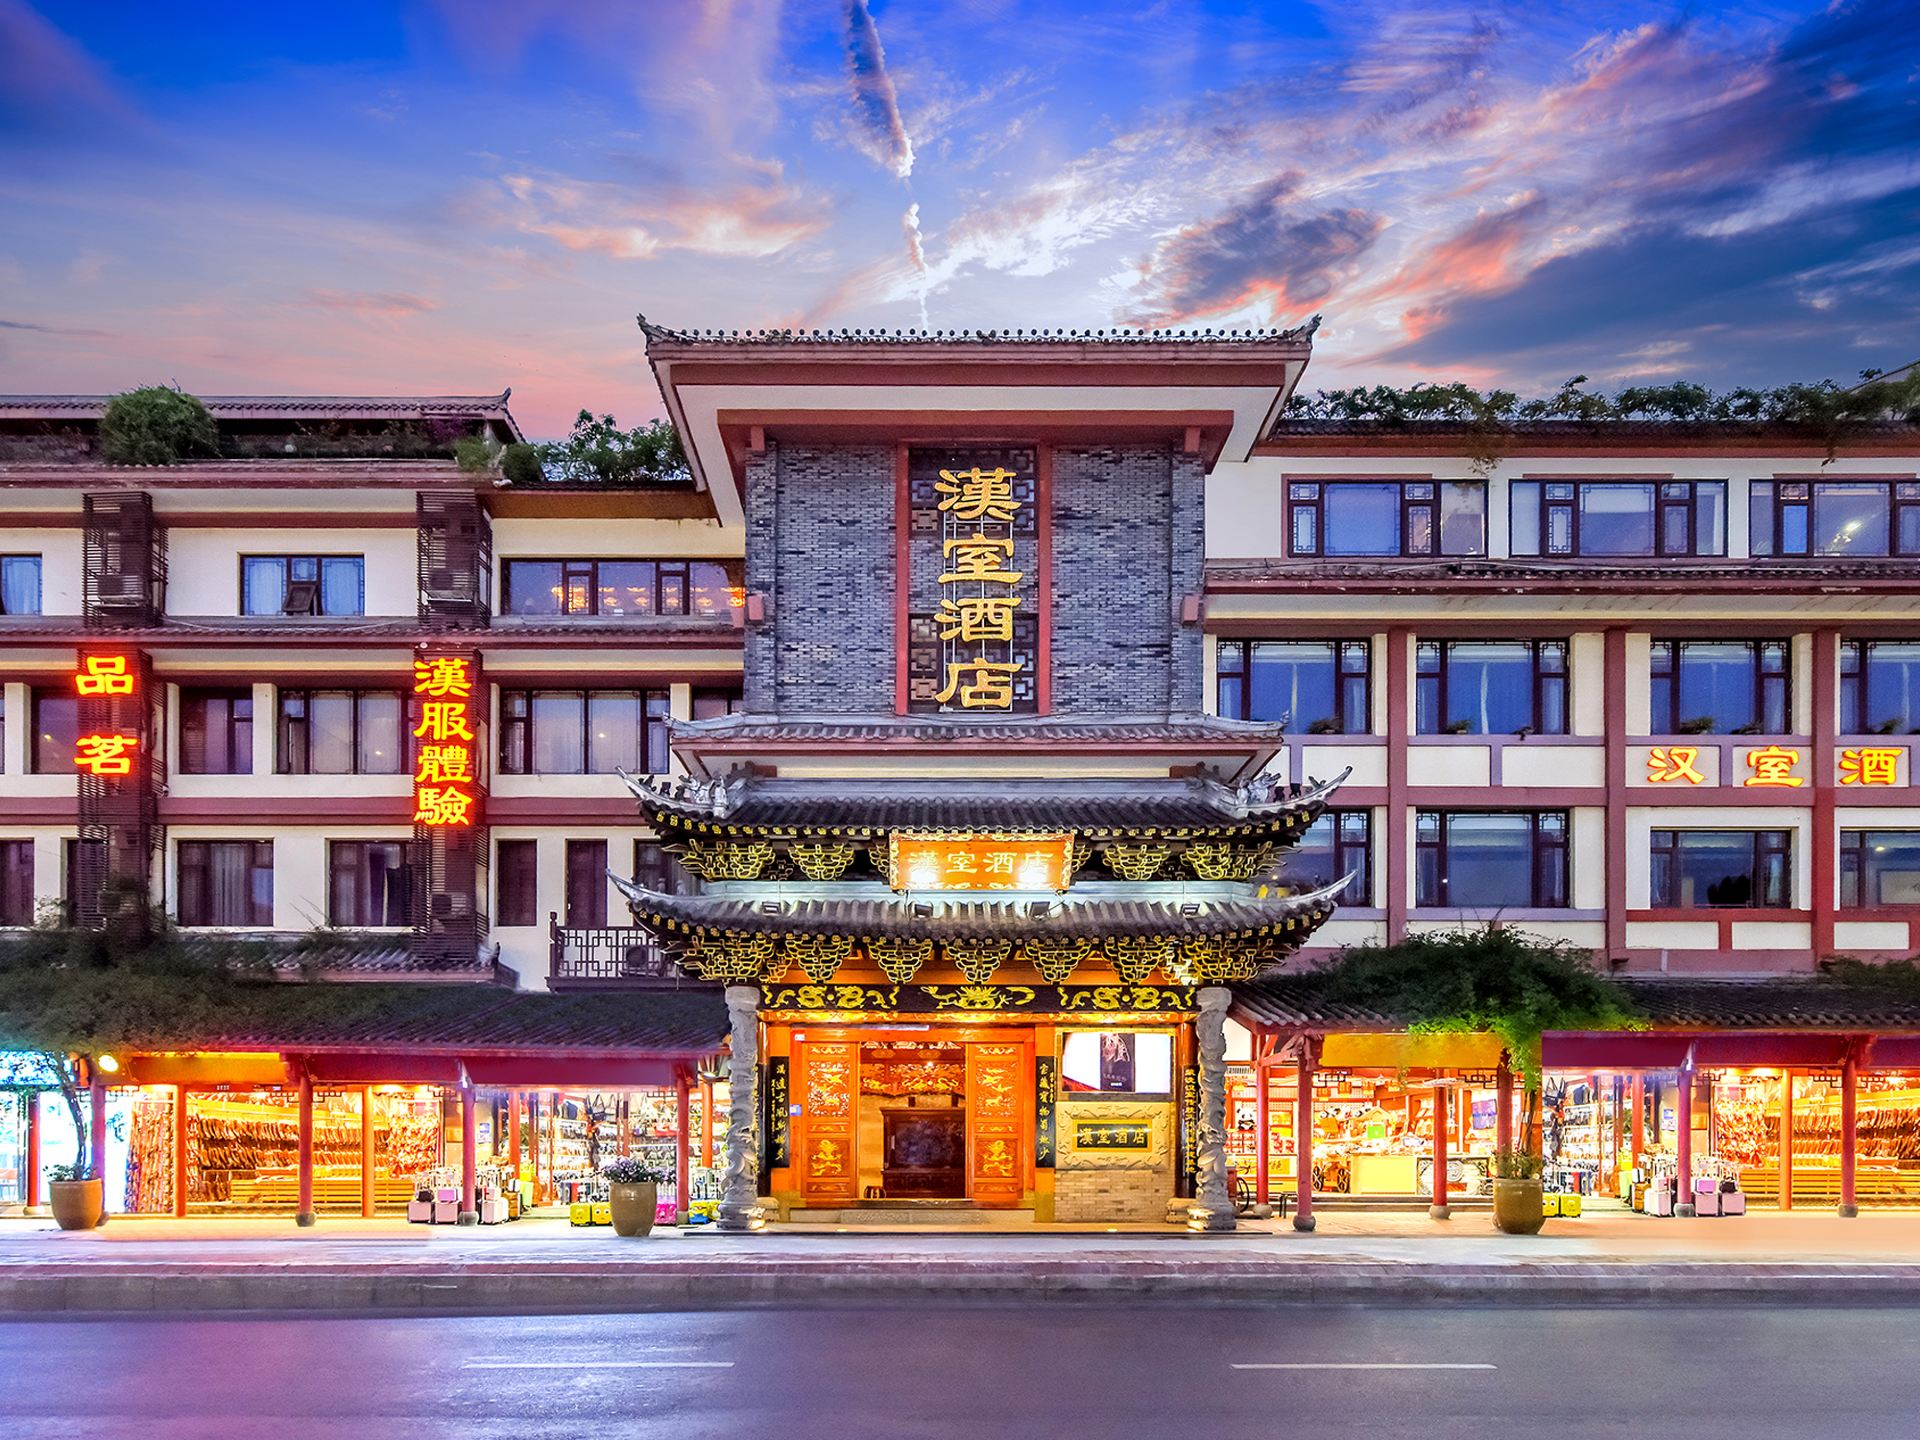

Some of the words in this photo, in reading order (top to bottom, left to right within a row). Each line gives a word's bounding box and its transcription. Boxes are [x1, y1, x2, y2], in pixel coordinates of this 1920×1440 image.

[934, 467, 1023, 707] 漢室酒店
[74, 656, 138, 774] 品茗
[413, 657, 474, 826] 漢服體驗
[1647, 746, 1903, 787] 汉室酒
[908, 850, 1054, 876] 漢室酒店
[1079, 1127, 1145, 1145] 漢室酒店
